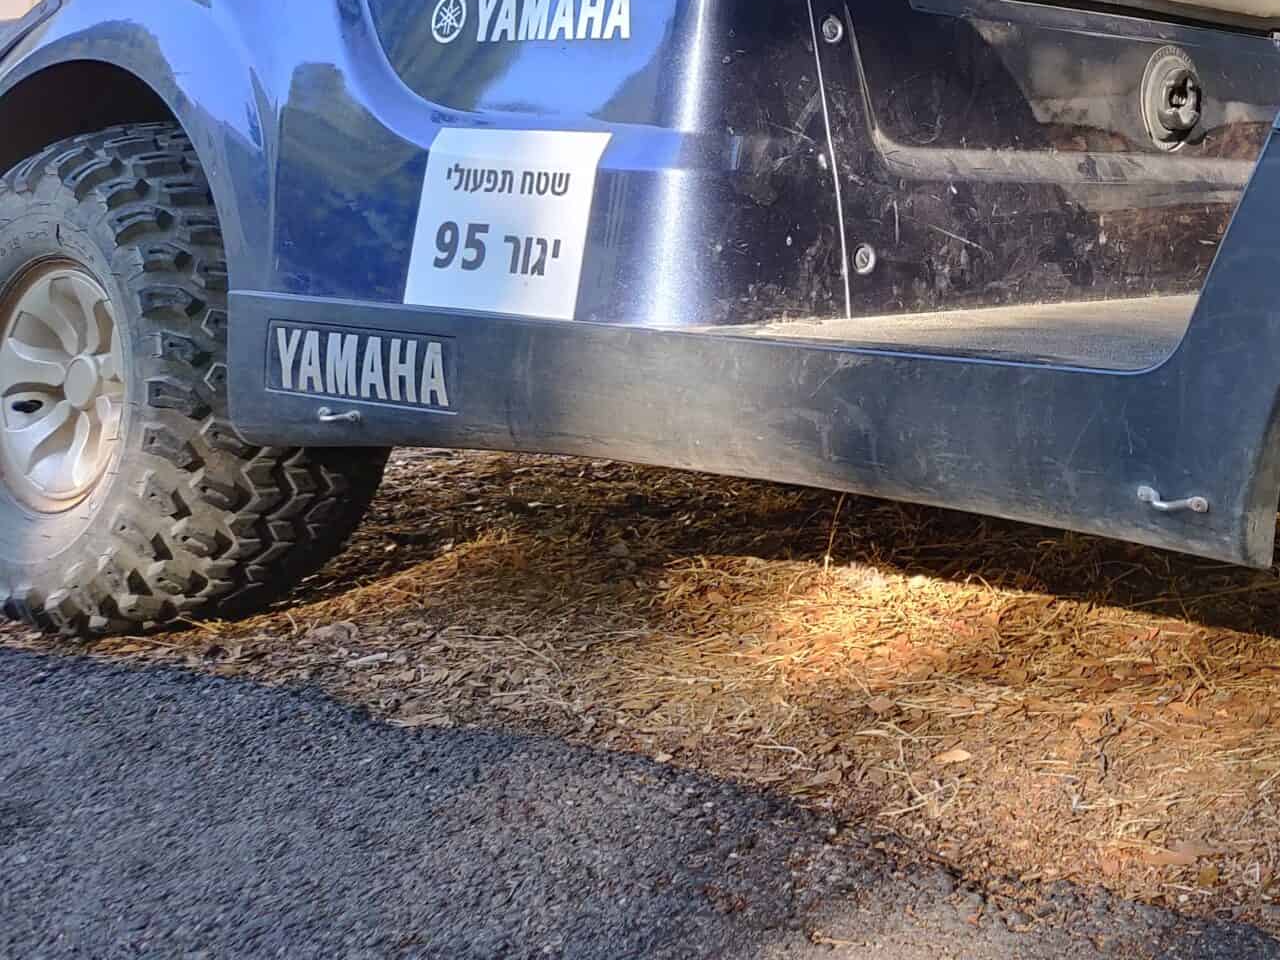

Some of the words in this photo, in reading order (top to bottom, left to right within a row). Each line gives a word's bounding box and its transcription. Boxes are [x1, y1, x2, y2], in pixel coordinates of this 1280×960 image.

[447, 163, 514, 194] תפעולי
[520, 170, 571, 196] שטח
[433, 220, 490, 271] 95
[504, 234, 561, 276] יגור
[276, 327, 449, 406] YAMAHA
